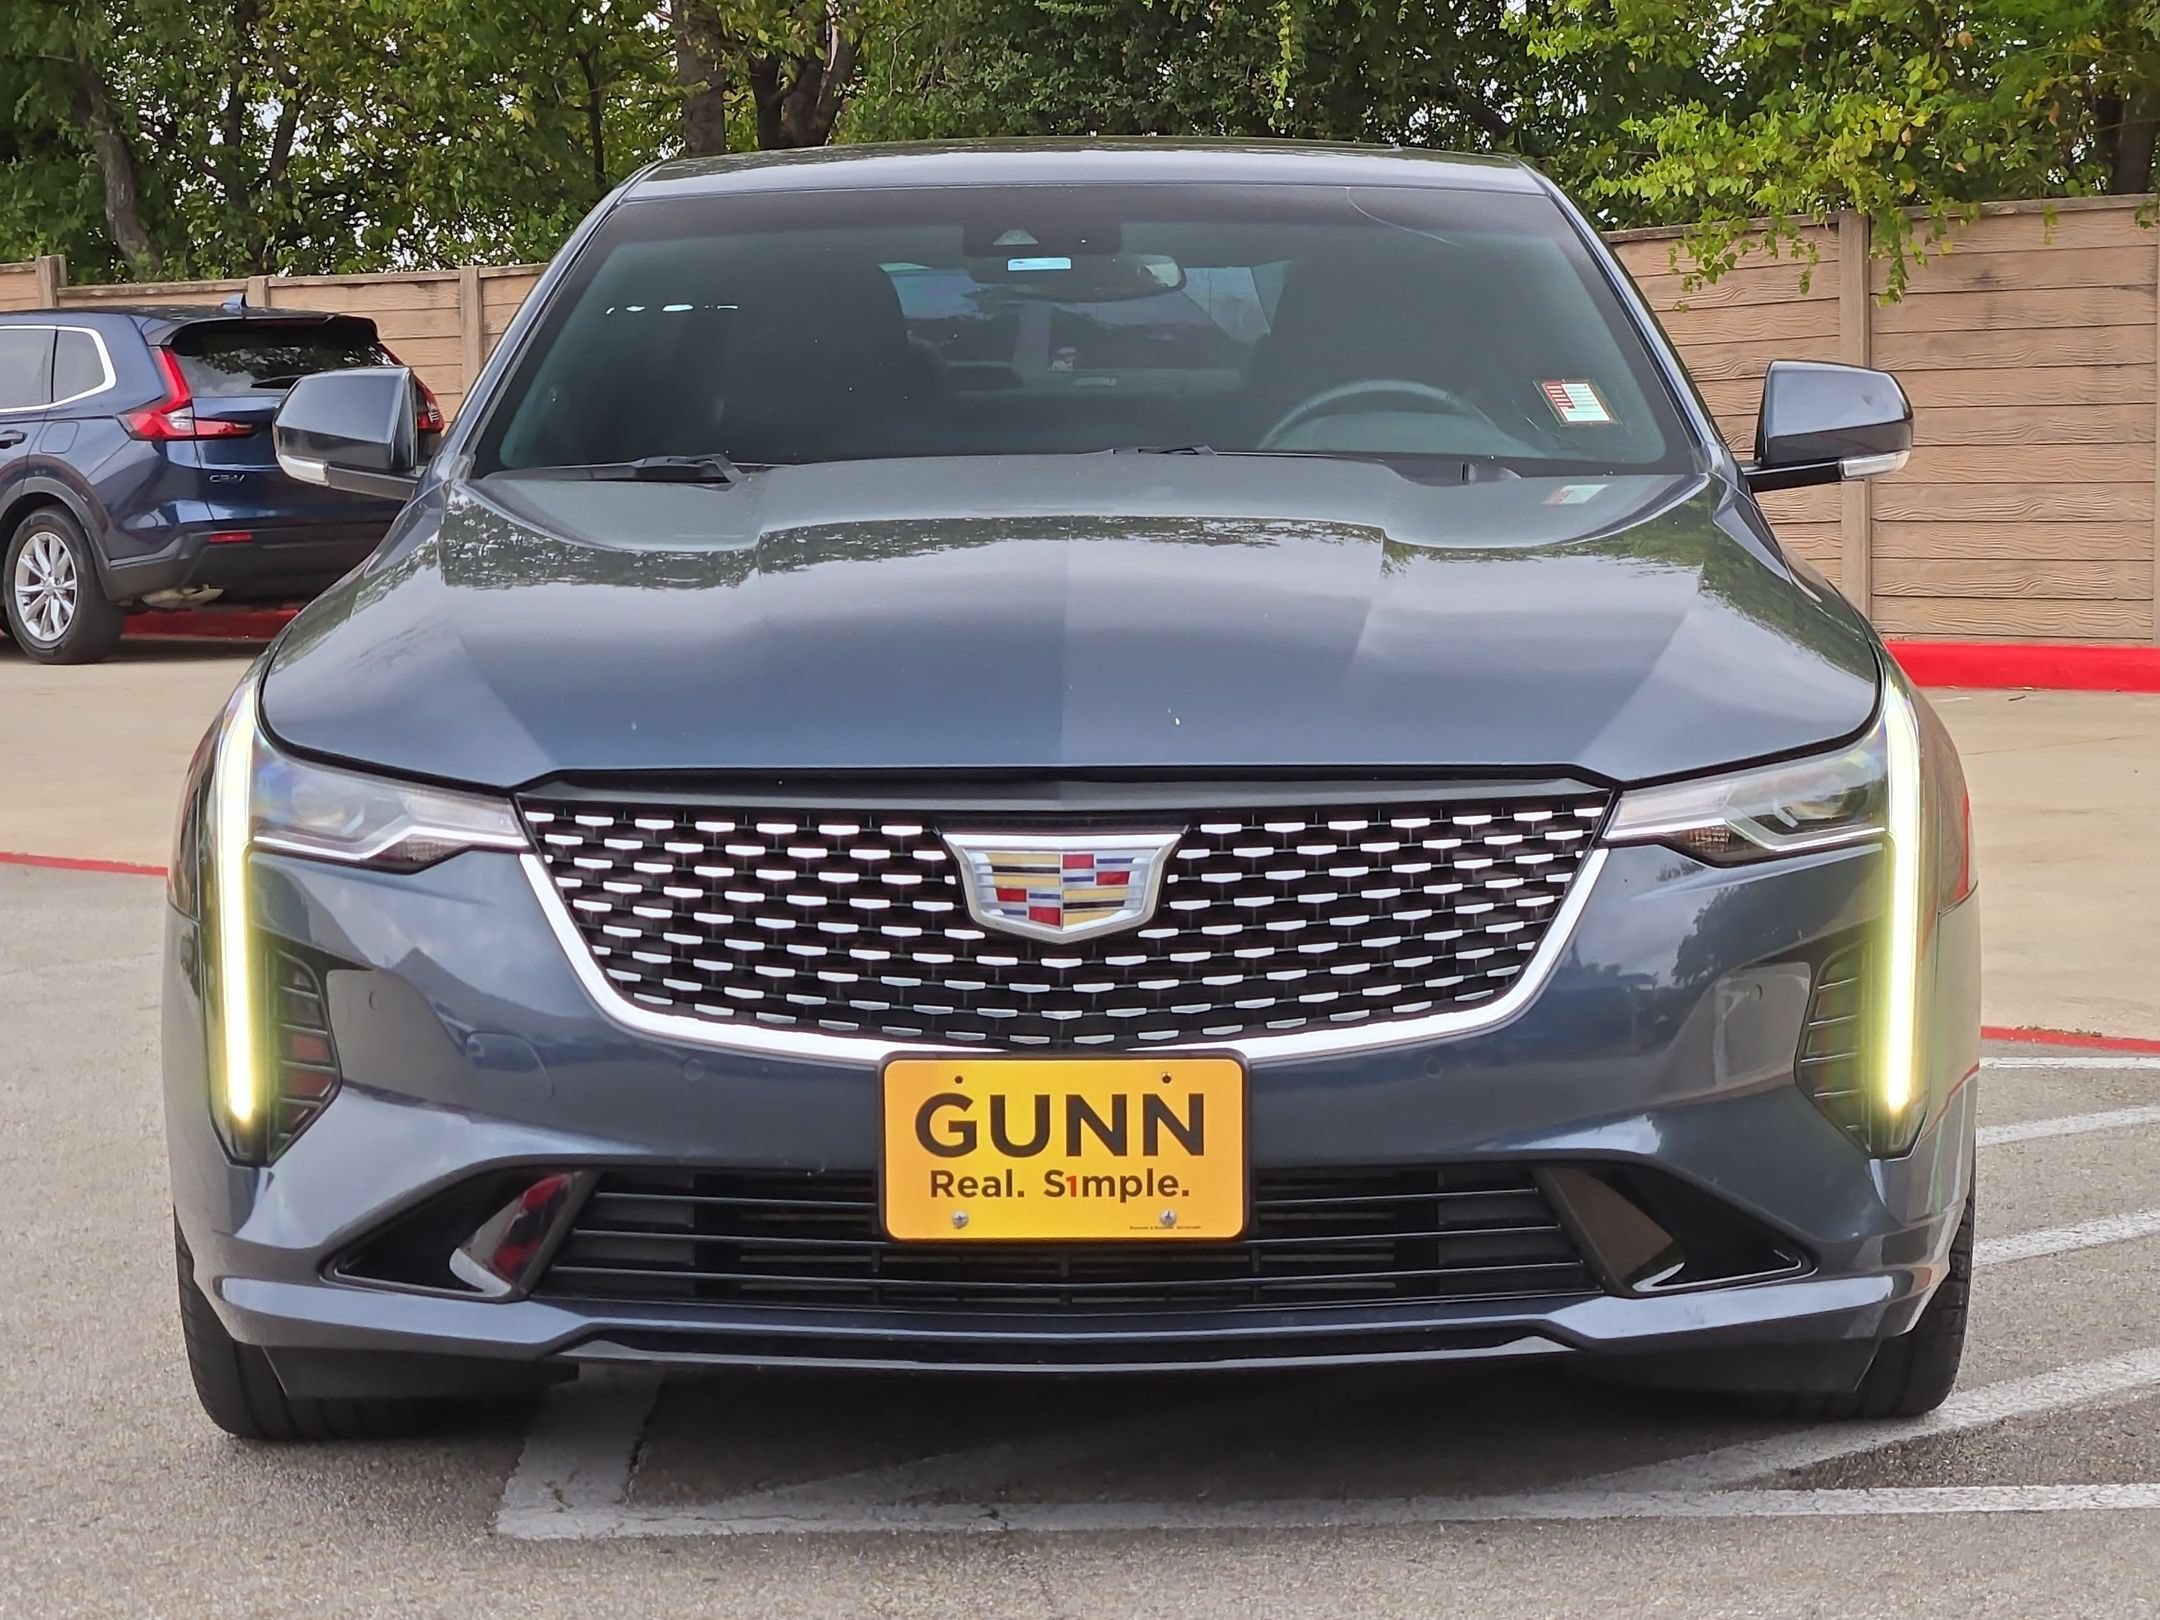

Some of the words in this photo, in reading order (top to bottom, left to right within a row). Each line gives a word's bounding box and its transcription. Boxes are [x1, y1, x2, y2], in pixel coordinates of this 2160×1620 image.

[914, 1092, 1205, 1158] GUNN
[930, 1169, 1025, 1198] Real.
[1043, 1168, 1190, 1203] S1mple.
